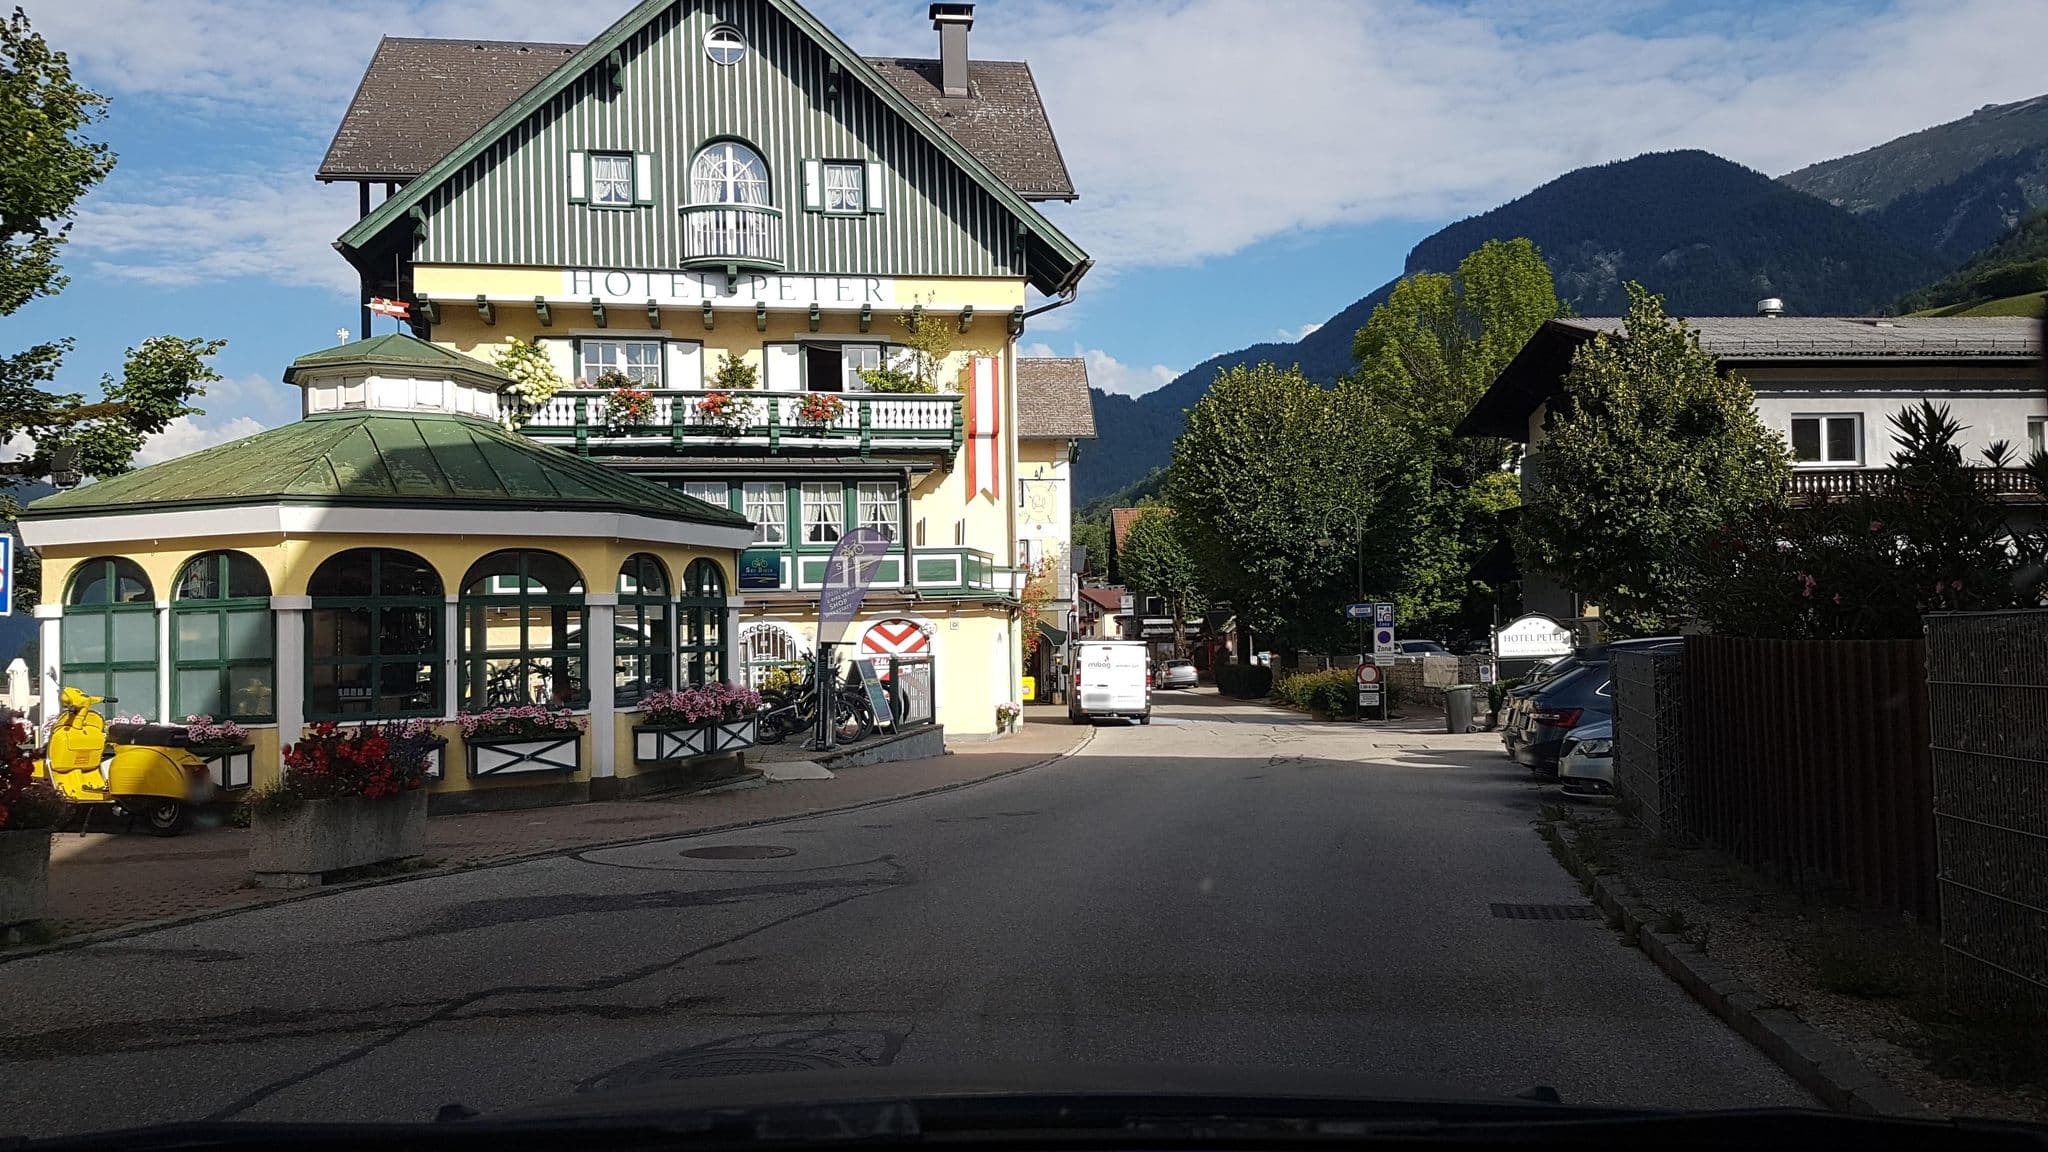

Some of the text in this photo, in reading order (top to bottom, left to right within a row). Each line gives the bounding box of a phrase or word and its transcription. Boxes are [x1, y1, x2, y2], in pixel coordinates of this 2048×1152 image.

[572, 269, 884, 302] HOTEL PETER
[829, 598, 848, 610] SHOP
[1503, 633, 1567, 642] HOTEL PETER
